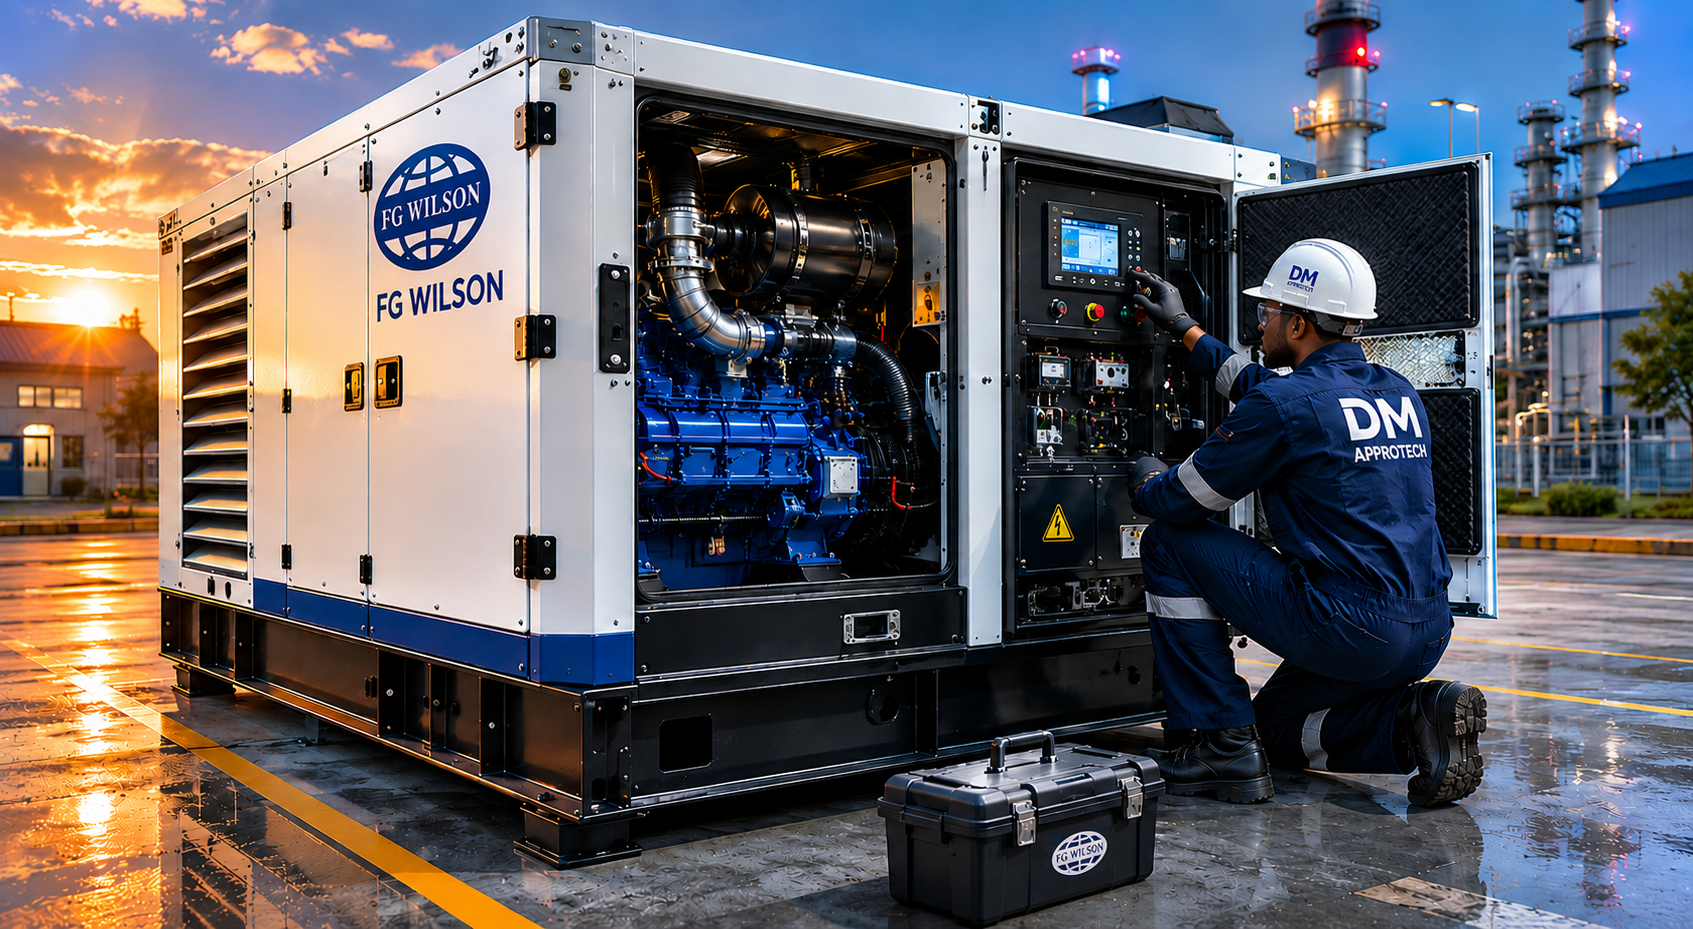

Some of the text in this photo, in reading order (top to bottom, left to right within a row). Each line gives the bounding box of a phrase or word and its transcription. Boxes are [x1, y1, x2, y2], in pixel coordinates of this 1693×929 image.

[381, 181, 481, 231] FG WILSON
[1288, 264, 1319, 287] DM
[376, 269, 504, 323] FG WILSON
[1338, 396, 1423, 441] DM
[1354, 443, 1428, 463] APPROTECH
[1056, 851, 1068, 863] FG
